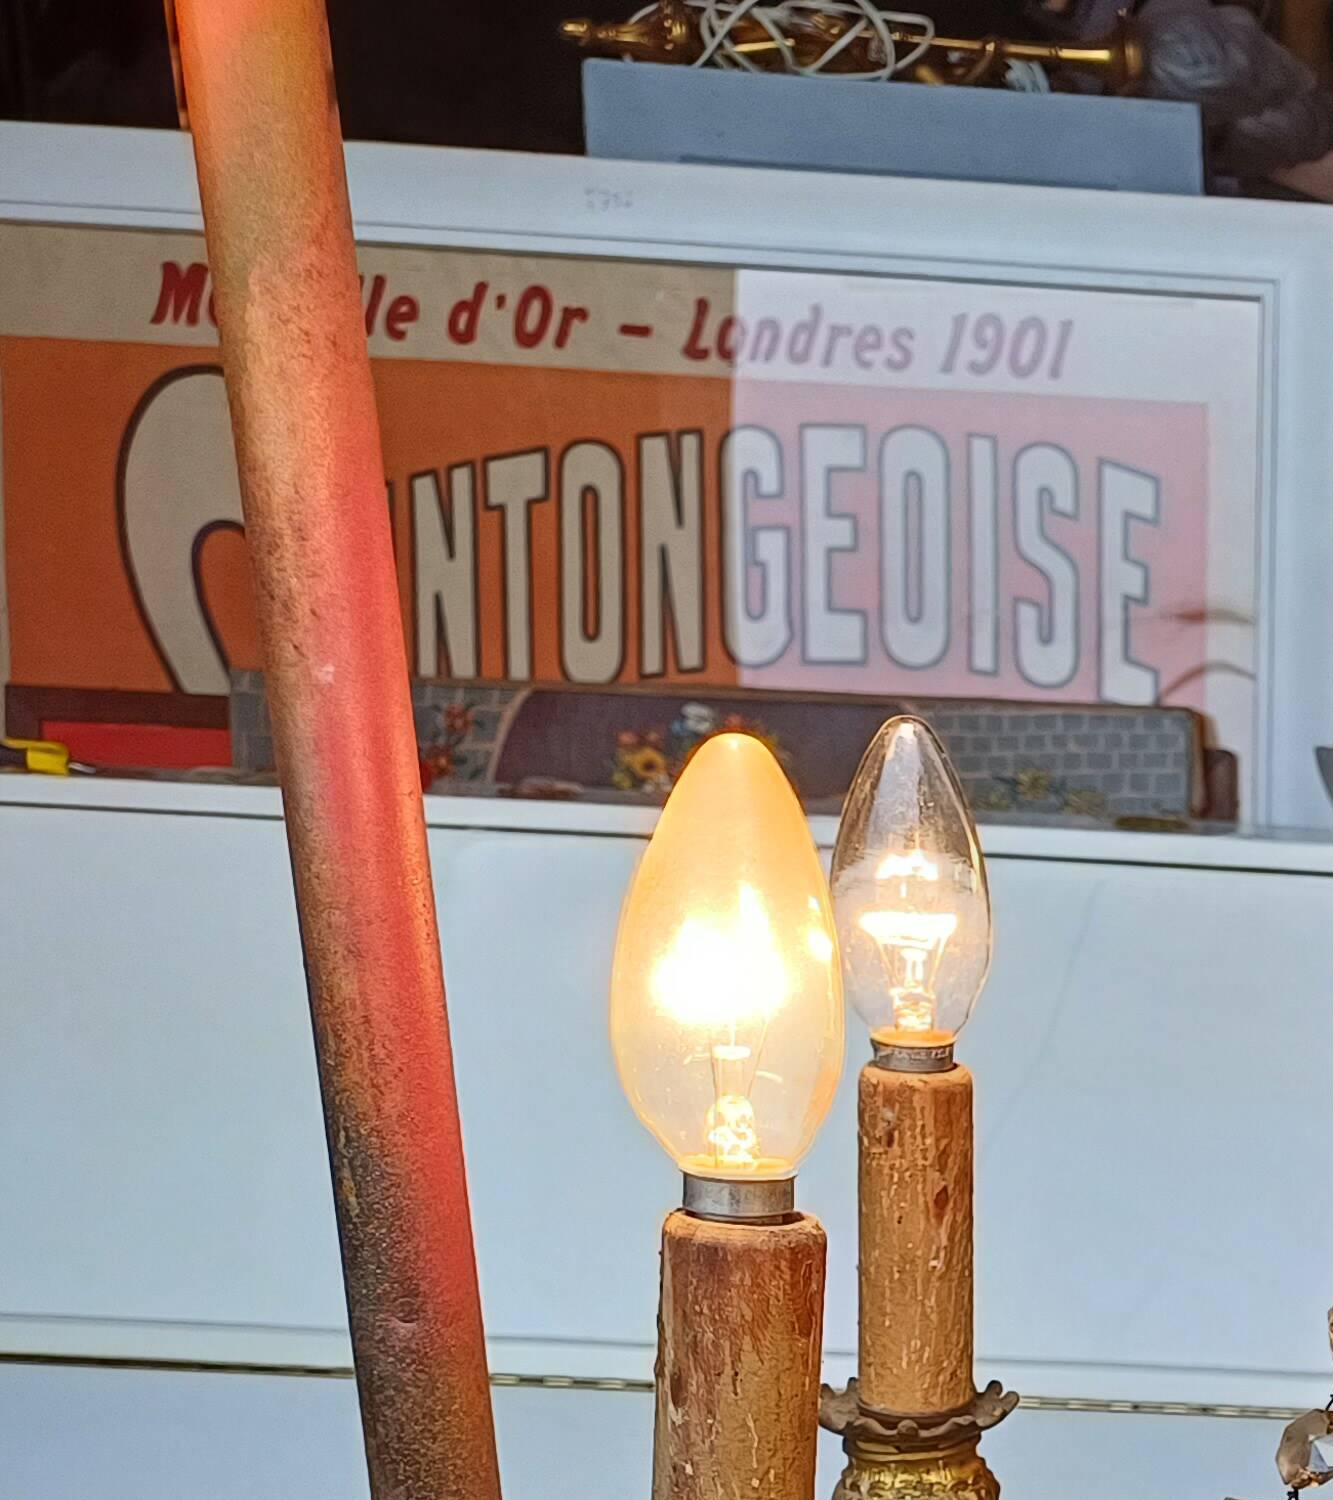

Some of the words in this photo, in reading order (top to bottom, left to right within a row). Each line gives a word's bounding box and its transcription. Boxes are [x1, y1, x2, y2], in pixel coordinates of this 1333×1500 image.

[447, 281, 590, 349] d'Or
[681, 297, 915, 372] Londres
[939, 311, 1075, 380] 1901
[116, 363, 1160, 706] NTONGEOISE
